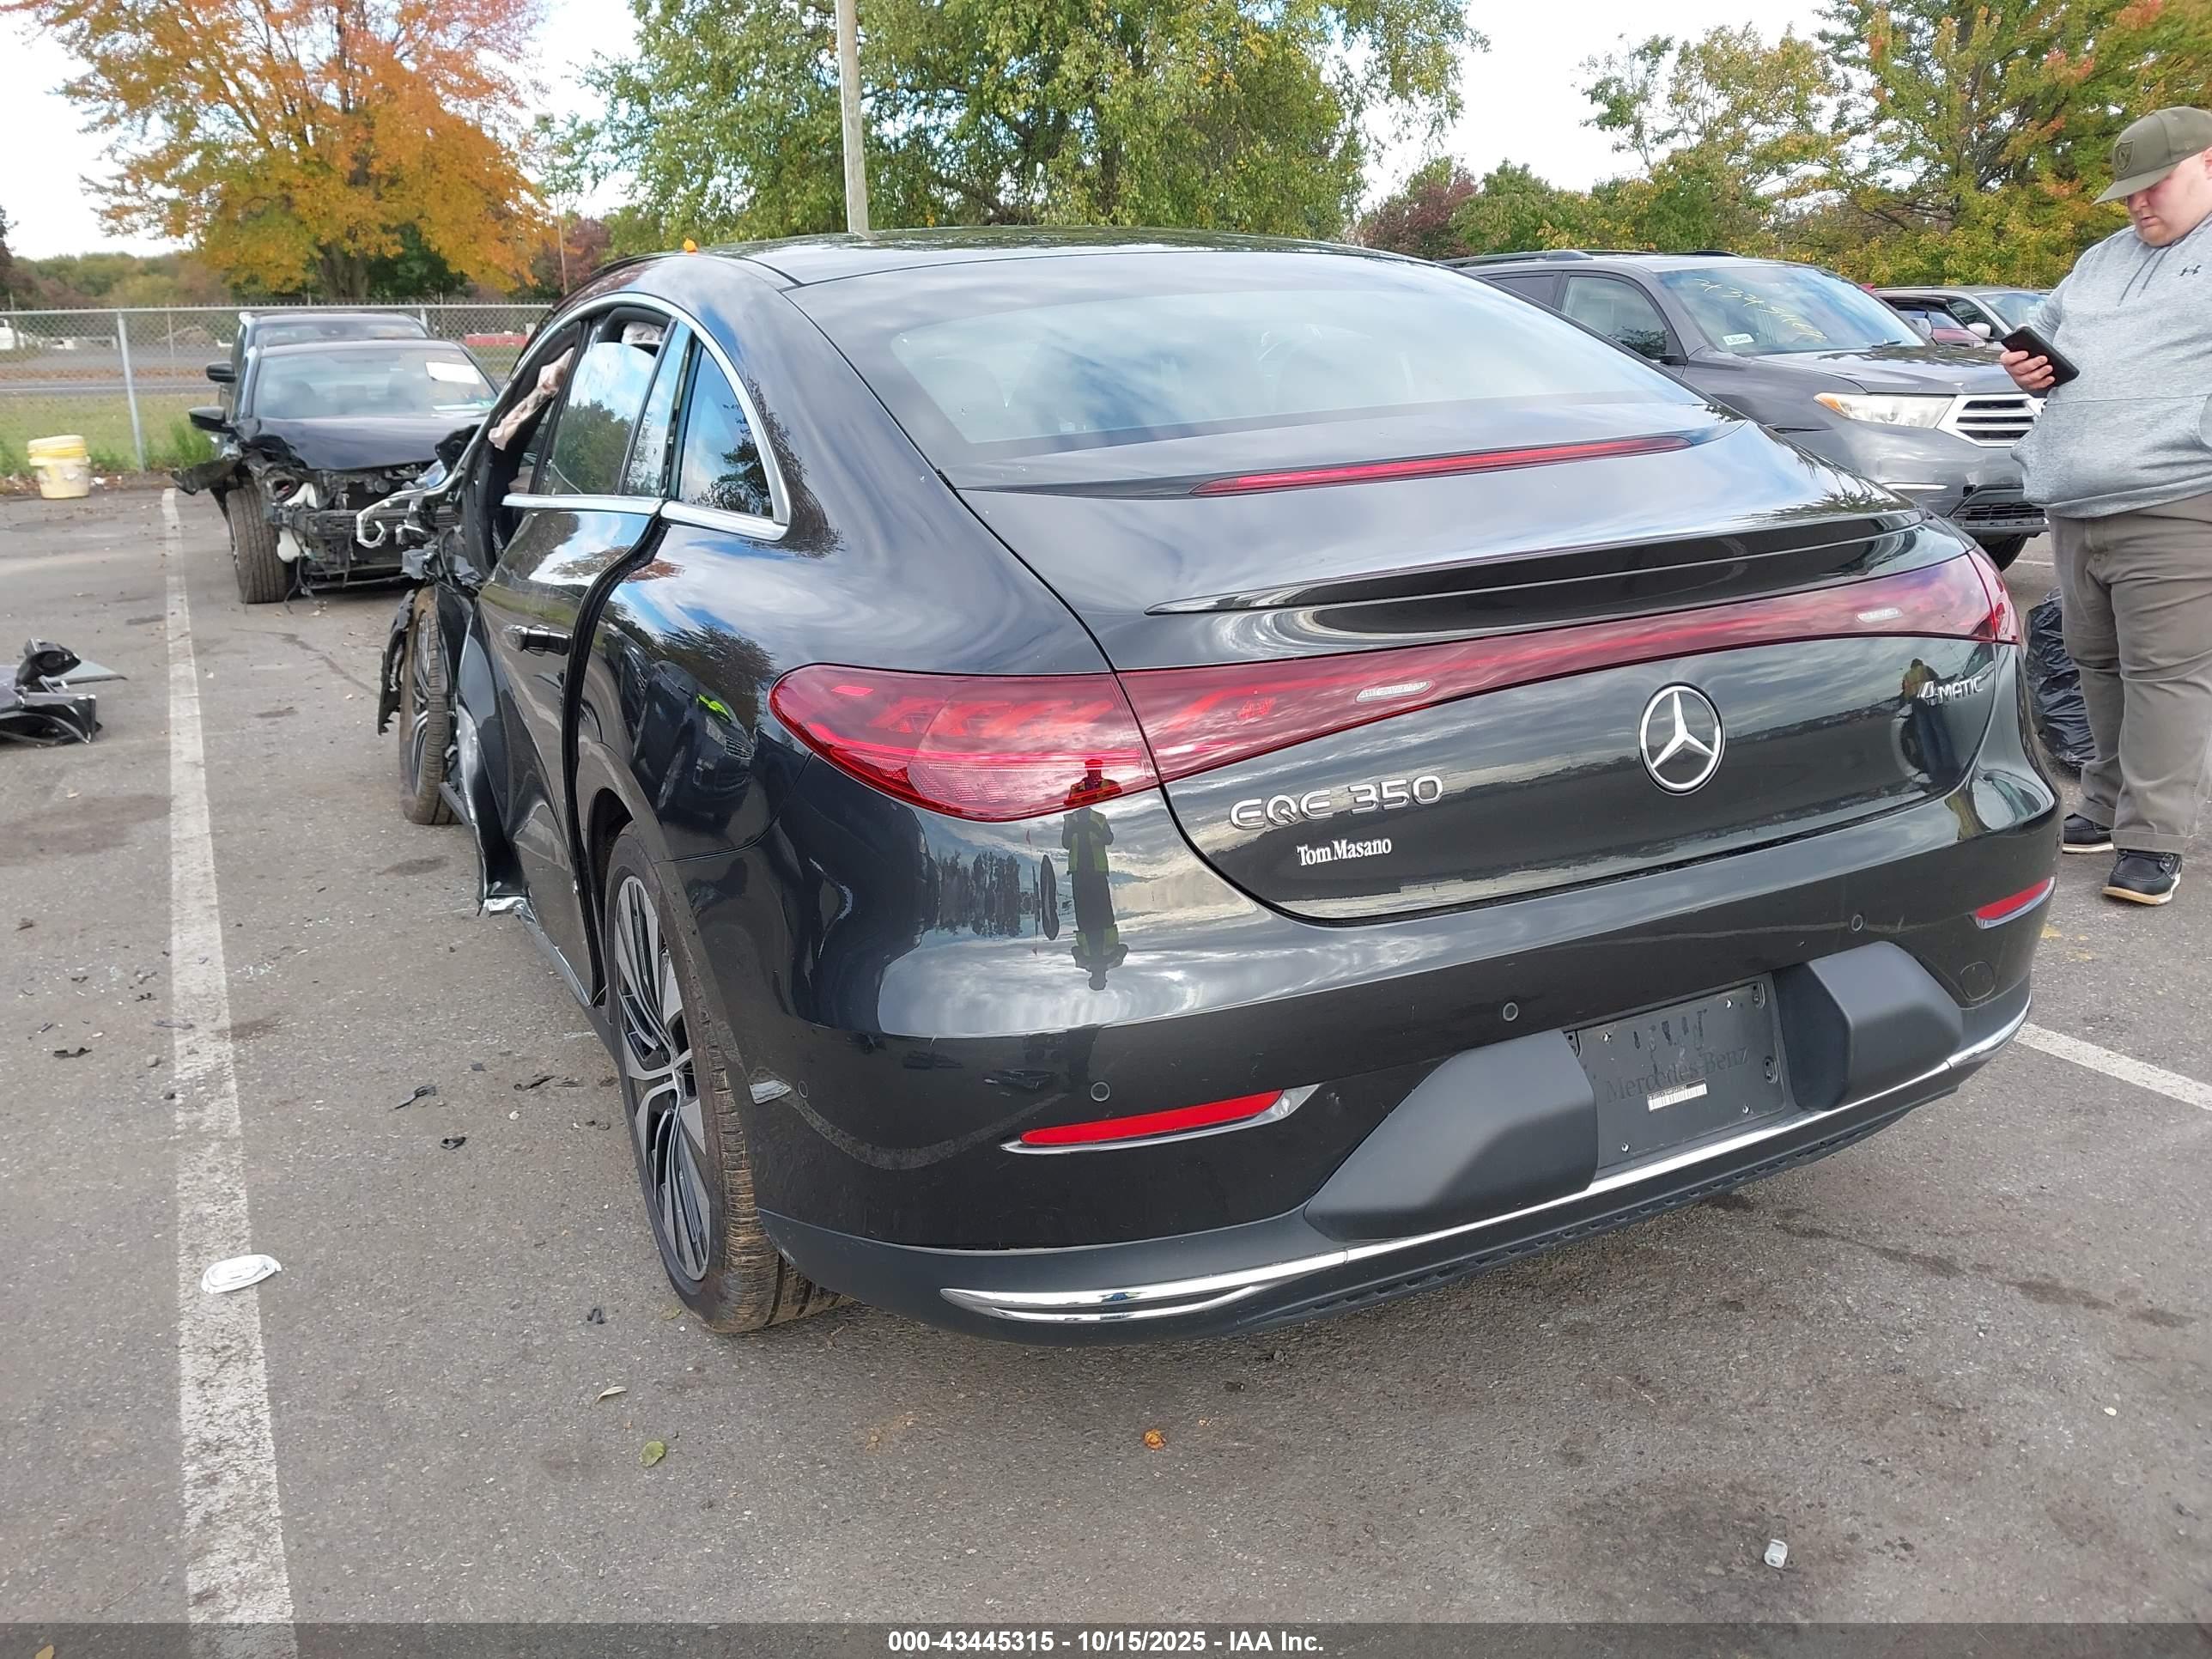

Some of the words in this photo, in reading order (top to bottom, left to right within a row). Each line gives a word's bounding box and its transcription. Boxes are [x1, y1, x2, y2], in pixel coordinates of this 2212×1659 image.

[1230, 788, 1334, 830] EQE
[1347, 775, 1444, 816] 350
[1296, 843, 1333, 866] Tom
[1333, 837, 1393, 861] Masano
